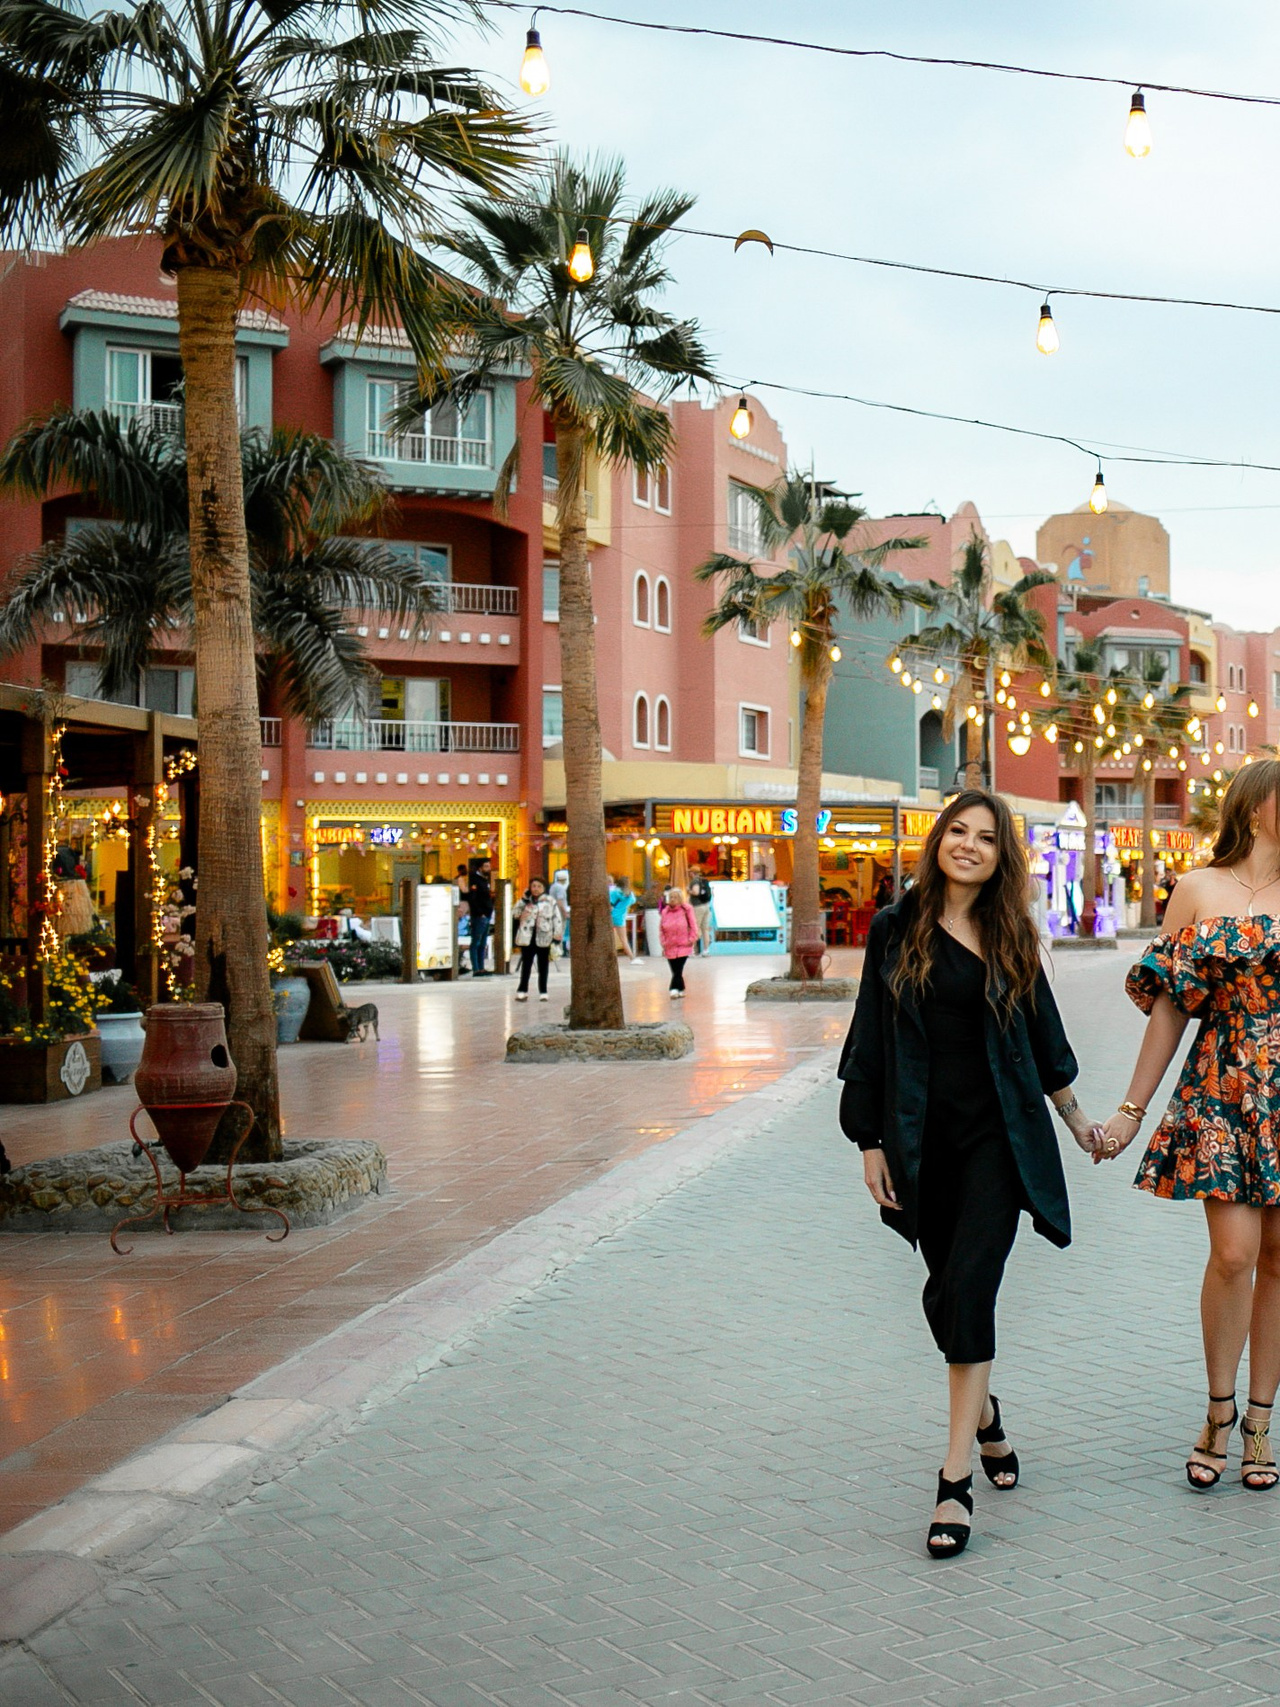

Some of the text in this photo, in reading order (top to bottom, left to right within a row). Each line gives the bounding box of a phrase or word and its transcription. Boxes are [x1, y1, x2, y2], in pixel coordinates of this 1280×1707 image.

[672, 808, 832, 834] NUBIAN SY
[1111, 826, 1140, 847] MEAT
[1166, 831, 1194, 850] WOOD
